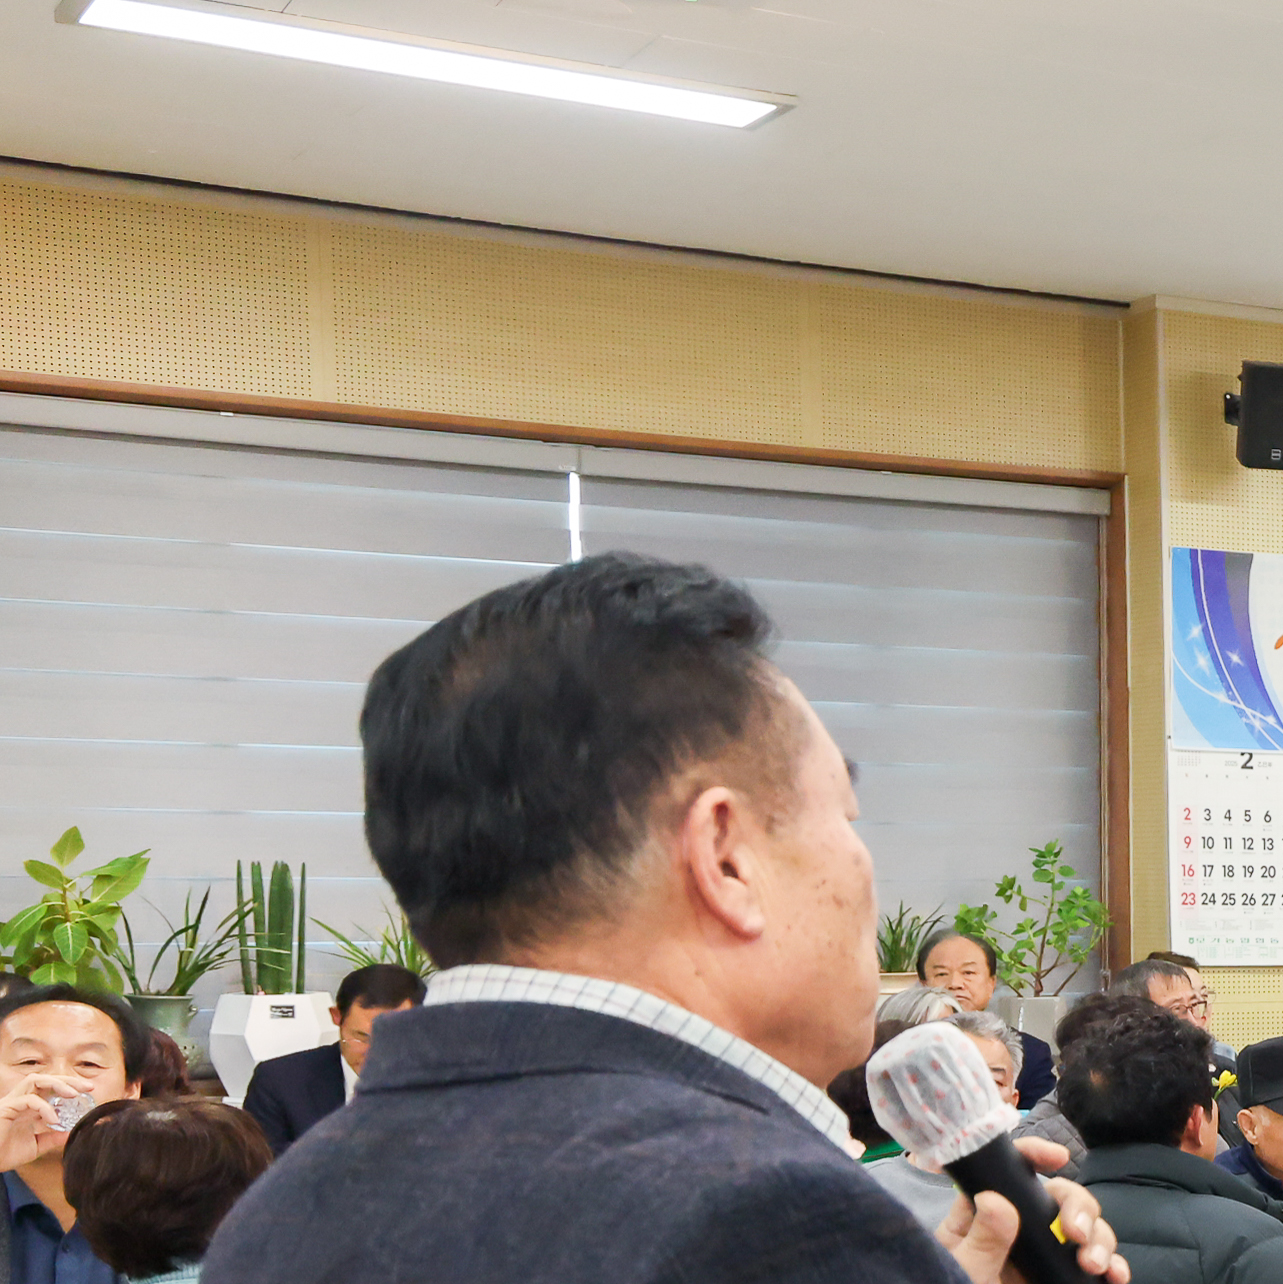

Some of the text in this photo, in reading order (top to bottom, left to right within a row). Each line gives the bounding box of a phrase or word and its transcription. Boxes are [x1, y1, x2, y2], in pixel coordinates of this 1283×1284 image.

[1240, 752, 1254, 769] 2
[1183, 808, 1192, 820] 2
[1204, 809, 1212, 821] 3
[1223, 810, 1232, 821] 4
[1244, 810, 1252, 822] 5
[1263, 811, 1272, 823] 6
[1183, 836, 1192, 848] 9
[1202, 837, 1215, 849] 10
[1223, 837, 1233, 849] 11
[1242, 838, 1254, 850] 12
[1262, 838, 1275, 850] 13
[1182, 864, 1195, 877] 16
[1203, 865, 1214, 877] 17
[1223, 865, 1235, 877] 18
[1243, 866, 1255, 877] 19
[1261, 866, 1277, 878] 20
[1181, 893, 1196, 905] 23
[1201, 893, 1217, 905] 24
[1222, 893, 1237, 906] 25
[1242, 893, 1257, 906] 26
[1262, 893, 1276, 906] 27
